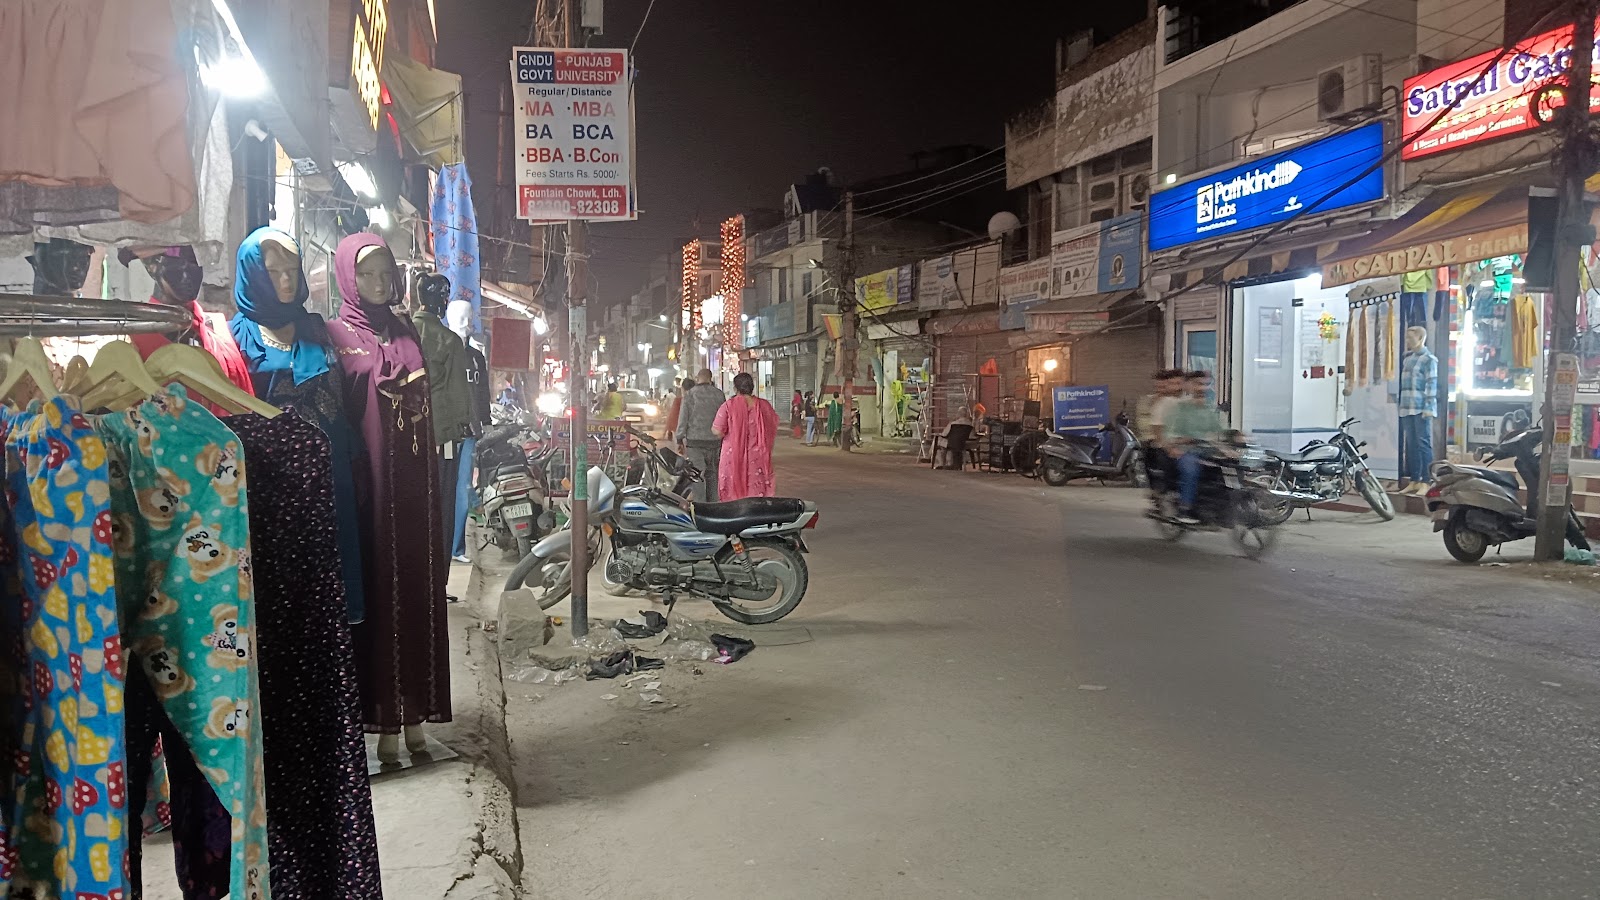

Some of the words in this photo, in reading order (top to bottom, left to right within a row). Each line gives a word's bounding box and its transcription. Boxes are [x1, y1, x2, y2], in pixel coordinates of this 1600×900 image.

[519, 54, 552, 66] GNDU
[566, 56, 612, 68] PUNJAB
[519, 70, 553, 80] GOVT.
[556, 70, 620, 82] UNIVERSITY
[1408, 64, 1499, 115] Satpal
[526, 101, 554, 116] MA
[573, 102, 616, 117] MBA
[526, 124, 552, 140] BA
[572, 124, 614, 140] BCA
[526, 148, 564, 163] BBA
[526, 170, 546, 178] Fees
[550, 170, 574, 178] Starts
[594, 170, 619, 178] 5000/-
[1214, 163, 1280, 204] Pathkind
[524, 188, 564, 198] Fountain
[566, 188, 600, 199] Chowk,
[1214, 202, 1236, 220] Labs
[1352, 241, 1457, 277] SATPAL
[1465, 234, 1528, 258] GARM
